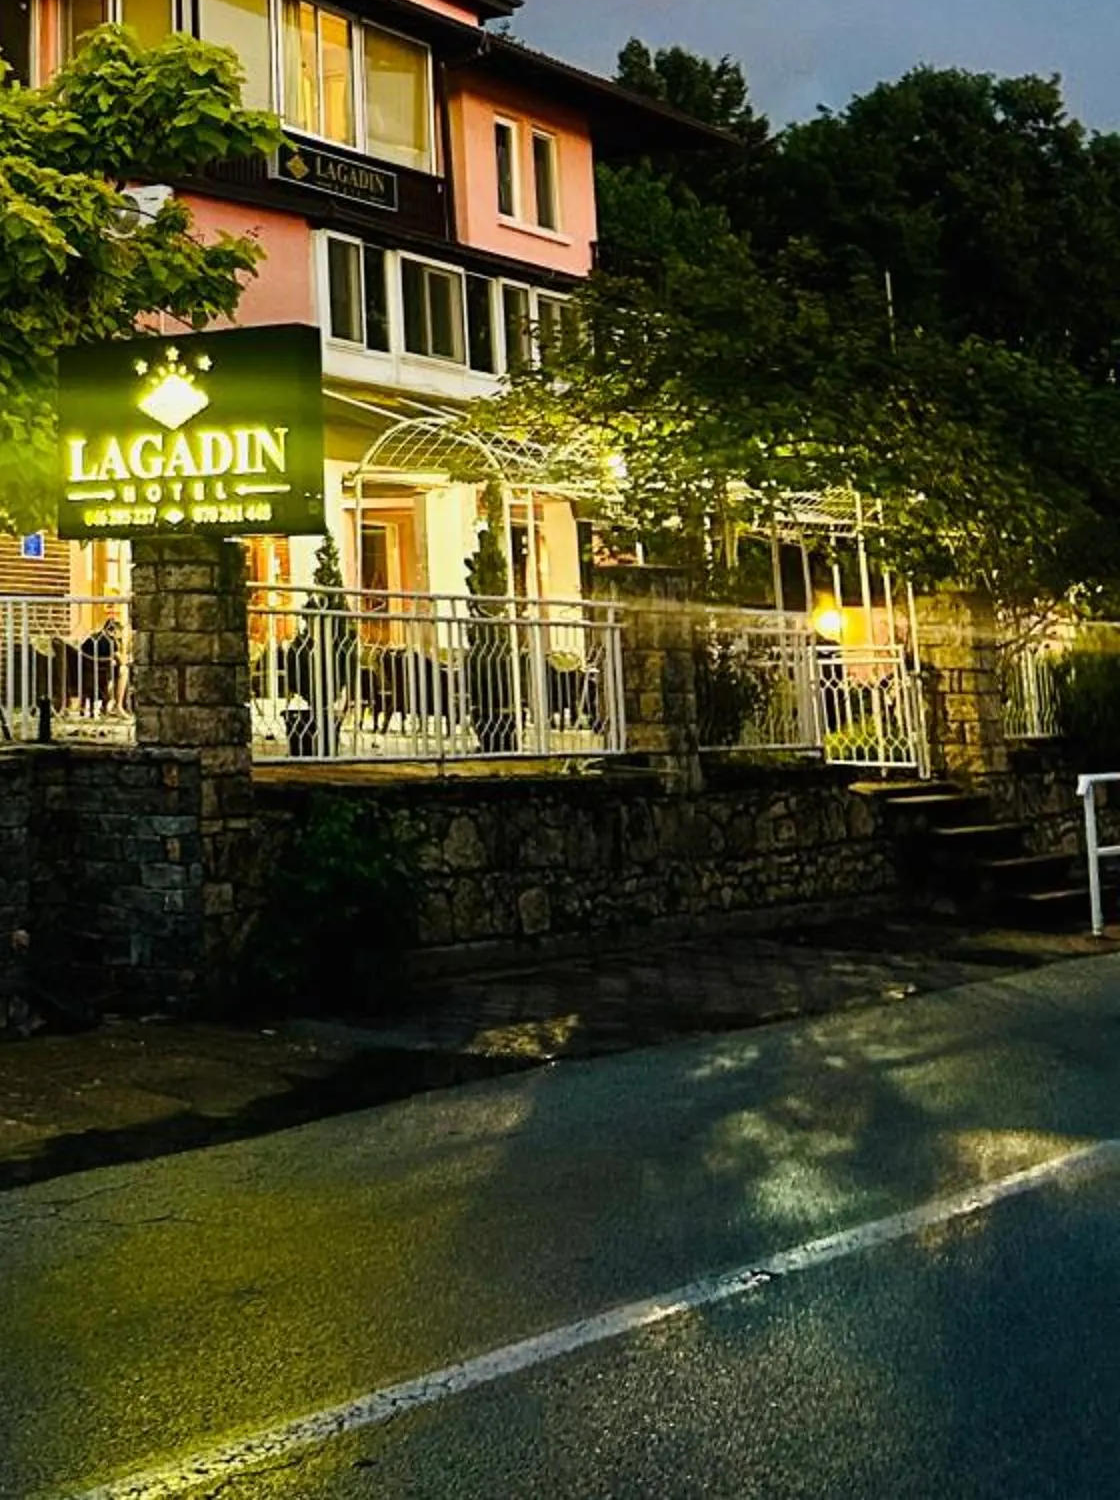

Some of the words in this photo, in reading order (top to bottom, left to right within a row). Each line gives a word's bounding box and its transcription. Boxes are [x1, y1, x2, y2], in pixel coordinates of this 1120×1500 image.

[315, 155, 385, 193] LAGADIN
[67, 427, 289, 482] LAGADIN
[122, 480, 227, 503] HOTEL
